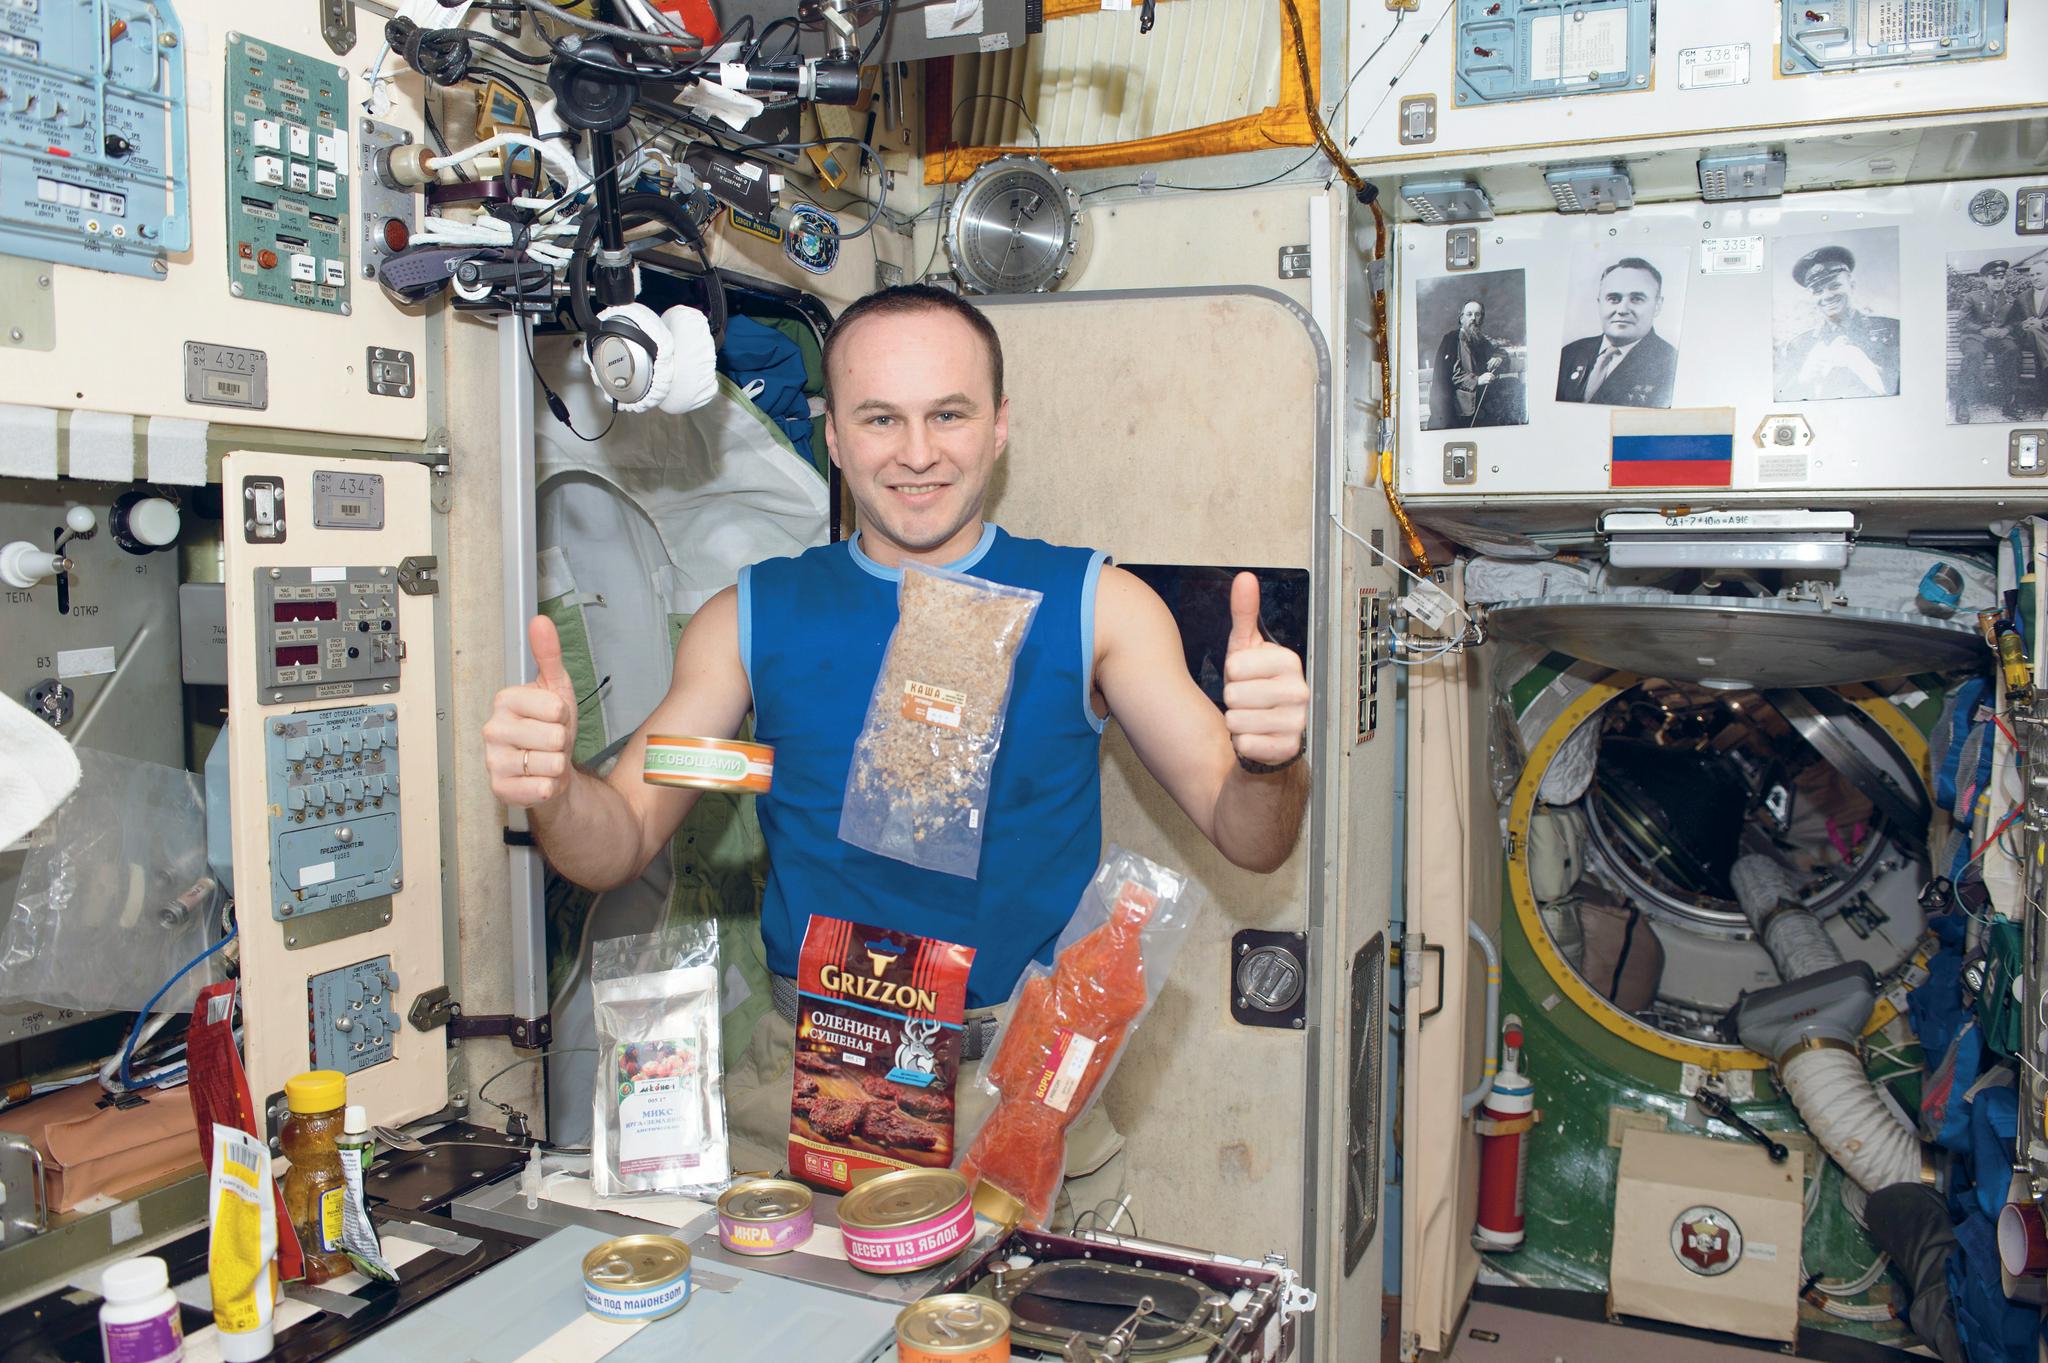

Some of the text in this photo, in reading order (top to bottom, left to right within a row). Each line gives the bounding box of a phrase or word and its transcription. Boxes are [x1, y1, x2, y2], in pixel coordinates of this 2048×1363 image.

[1704, 49, 1730, 62] 338
[1723, 240, 1746, 250] 339
[216, 352, 246, 370] 432
[340, 478, 365, 494] 434
[6, 592, 33, 604] ТЕПЛ
[73, 606, 99, 618] ОТКР
[910, 682, 940, 698] КАША
[667, 752, 740, 771] ОВОЩАМИ
[820, 964, 938, 1014] GRIZZON
[811, 1010, 892, 1045] ОЛЕНИНА
[809, 1027, 874, 1054] СУШЕНАЯ
[1036, 1069, 1055, 1098] БОРЩ
[642, 1108, 674, 1119] МИКС
[734, 1225, 770, 1242] ИКРА
[852, 1224, 959, 1258] ДЕСЕРТ ИЗ ЯБЛОК
[604, 1298, 622, 1311] ПОД
[624, 1286, 682, 1310] МАЙОНЕЗОМ
